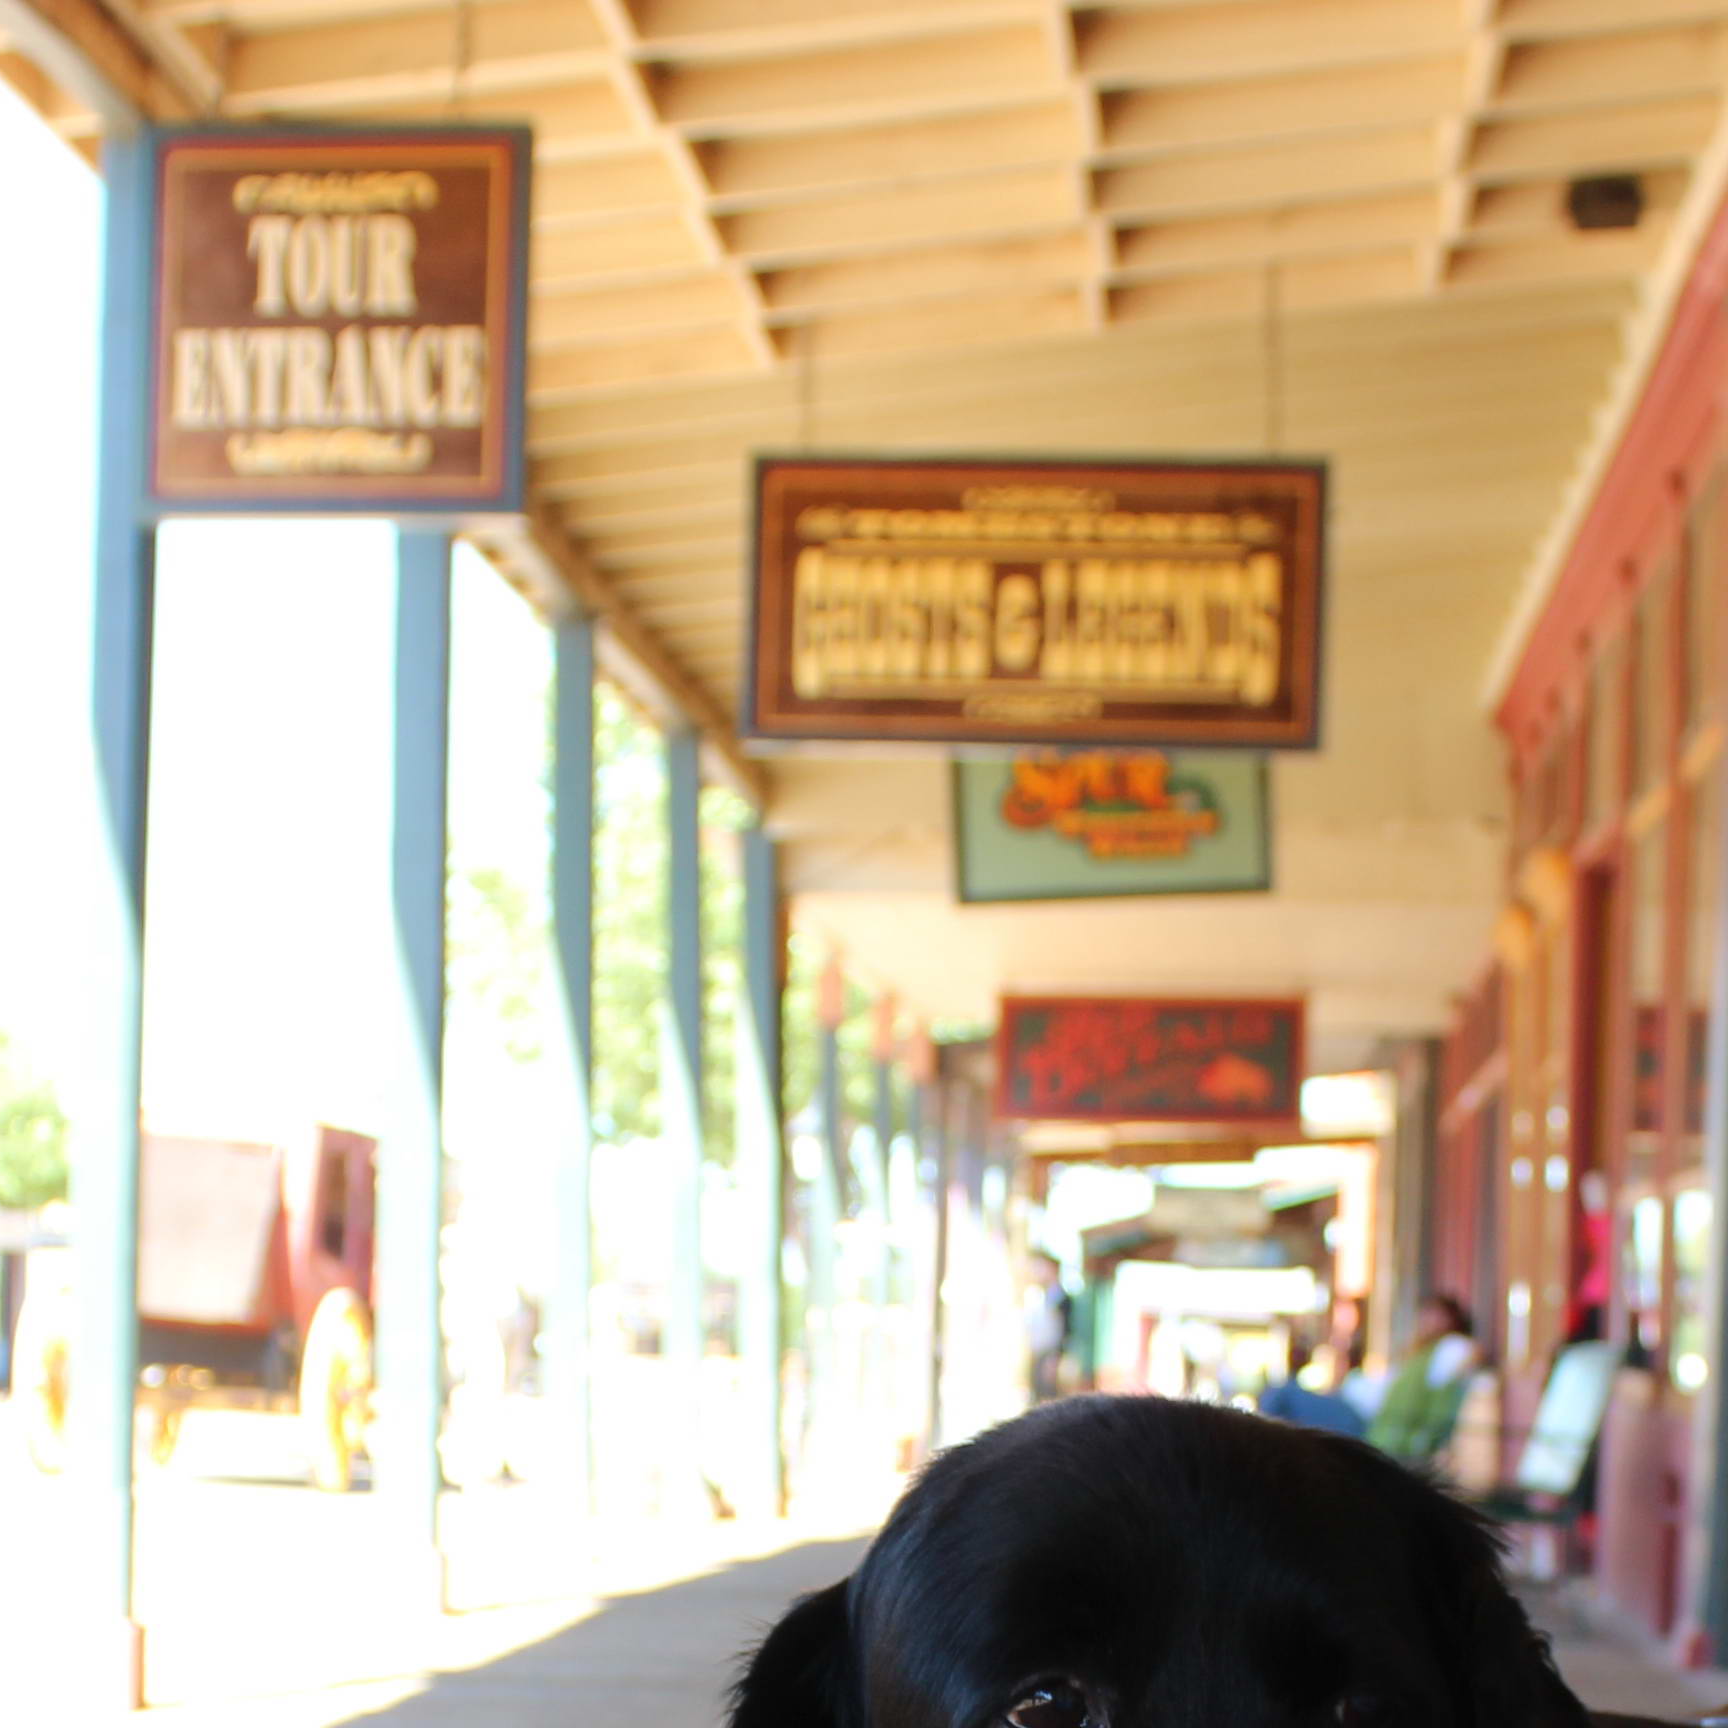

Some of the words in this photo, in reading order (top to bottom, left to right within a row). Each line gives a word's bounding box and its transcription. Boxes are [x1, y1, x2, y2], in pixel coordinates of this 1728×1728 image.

[247, 213, 419, 318] TOUR
[173, 324, 487, 431] ENTRANCE
[995, 573, 1041, 671] &
[1040, 552, 1283, 708] LEGENDS
